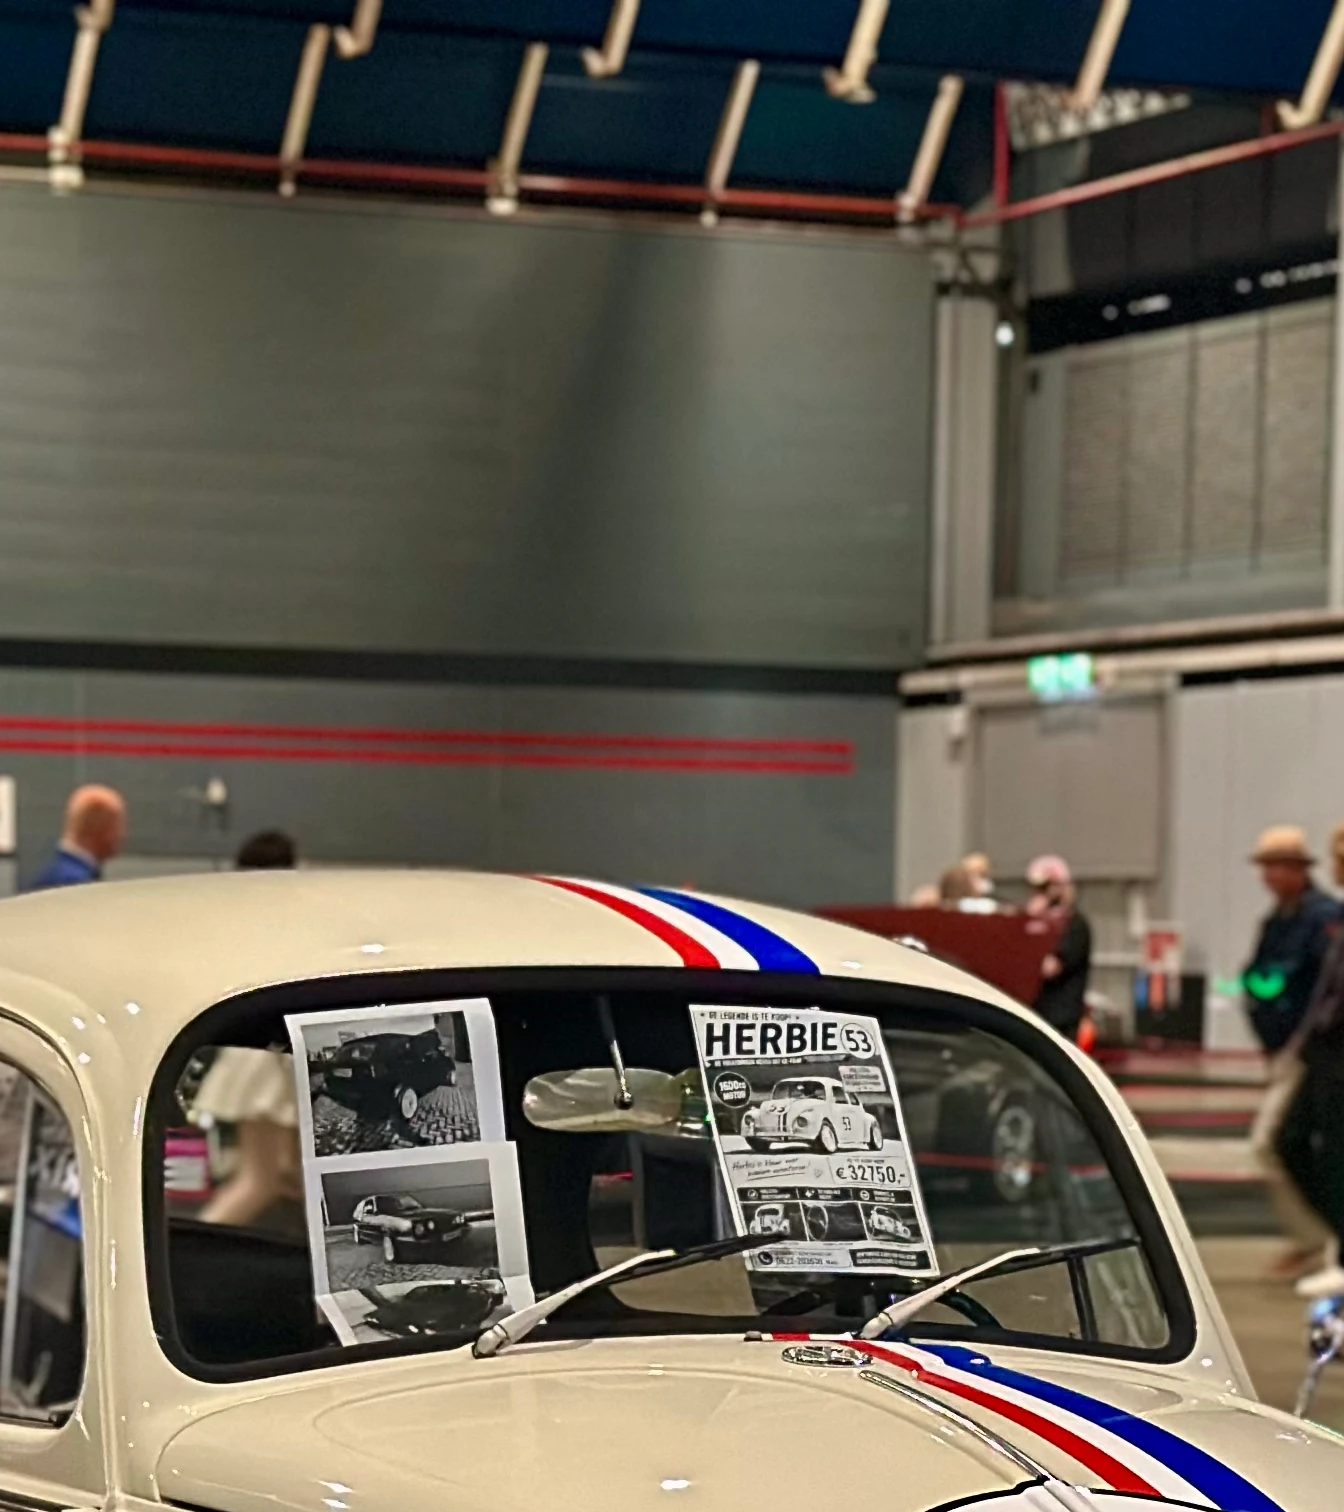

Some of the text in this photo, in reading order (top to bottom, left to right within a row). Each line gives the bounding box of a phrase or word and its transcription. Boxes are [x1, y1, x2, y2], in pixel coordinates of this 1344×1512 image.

[761, 1012, 769, 1021] TE
[705, 1022, 838, 1057] HERBIE
[845, 1029, 872, 1053] 53
